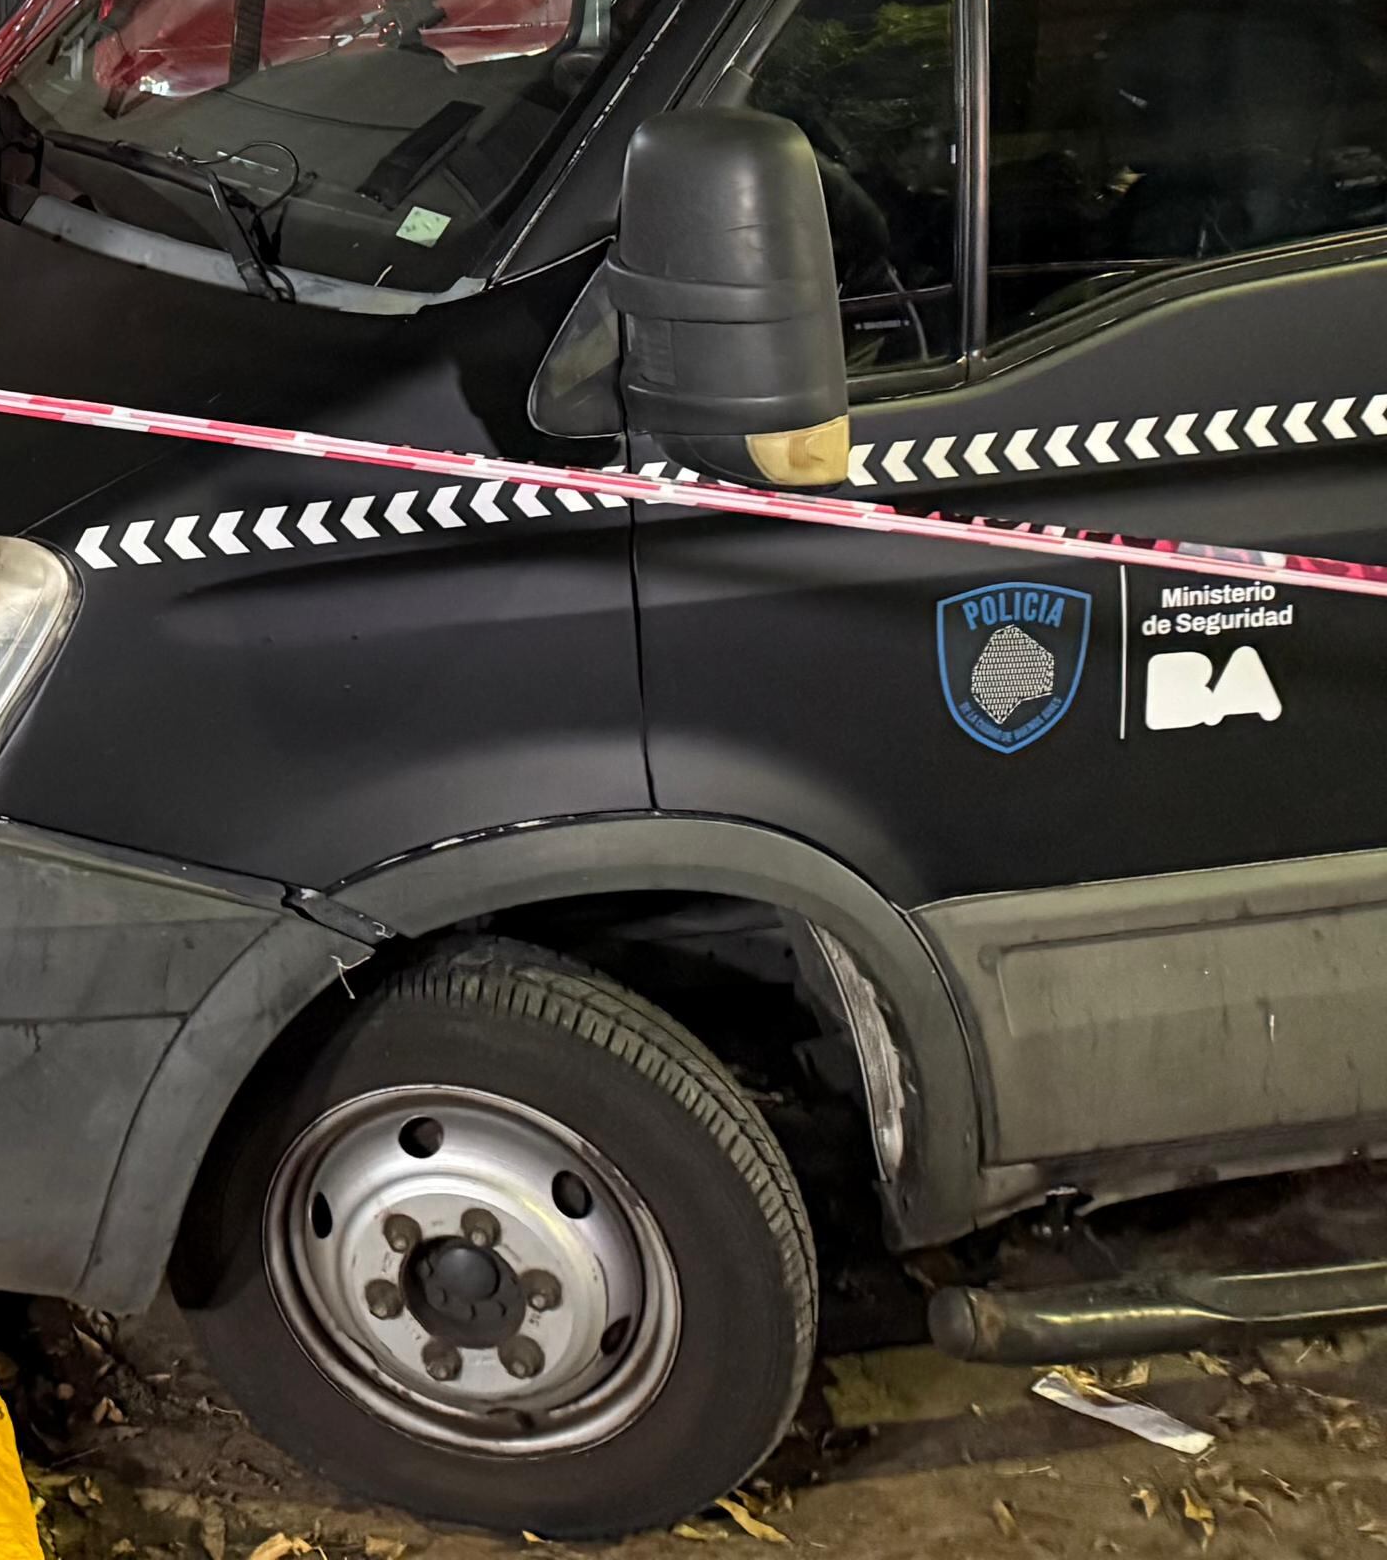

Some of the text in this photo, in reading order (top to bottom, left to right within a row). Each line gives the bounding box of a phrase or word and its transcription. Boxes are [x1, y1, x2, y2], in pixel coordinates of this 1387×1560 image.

[962, 591, 1066, 630] POLICIA
[1161, 581, 1275, 608] Ministerio
[1142, 604, 1293, 636] de Seguridad
